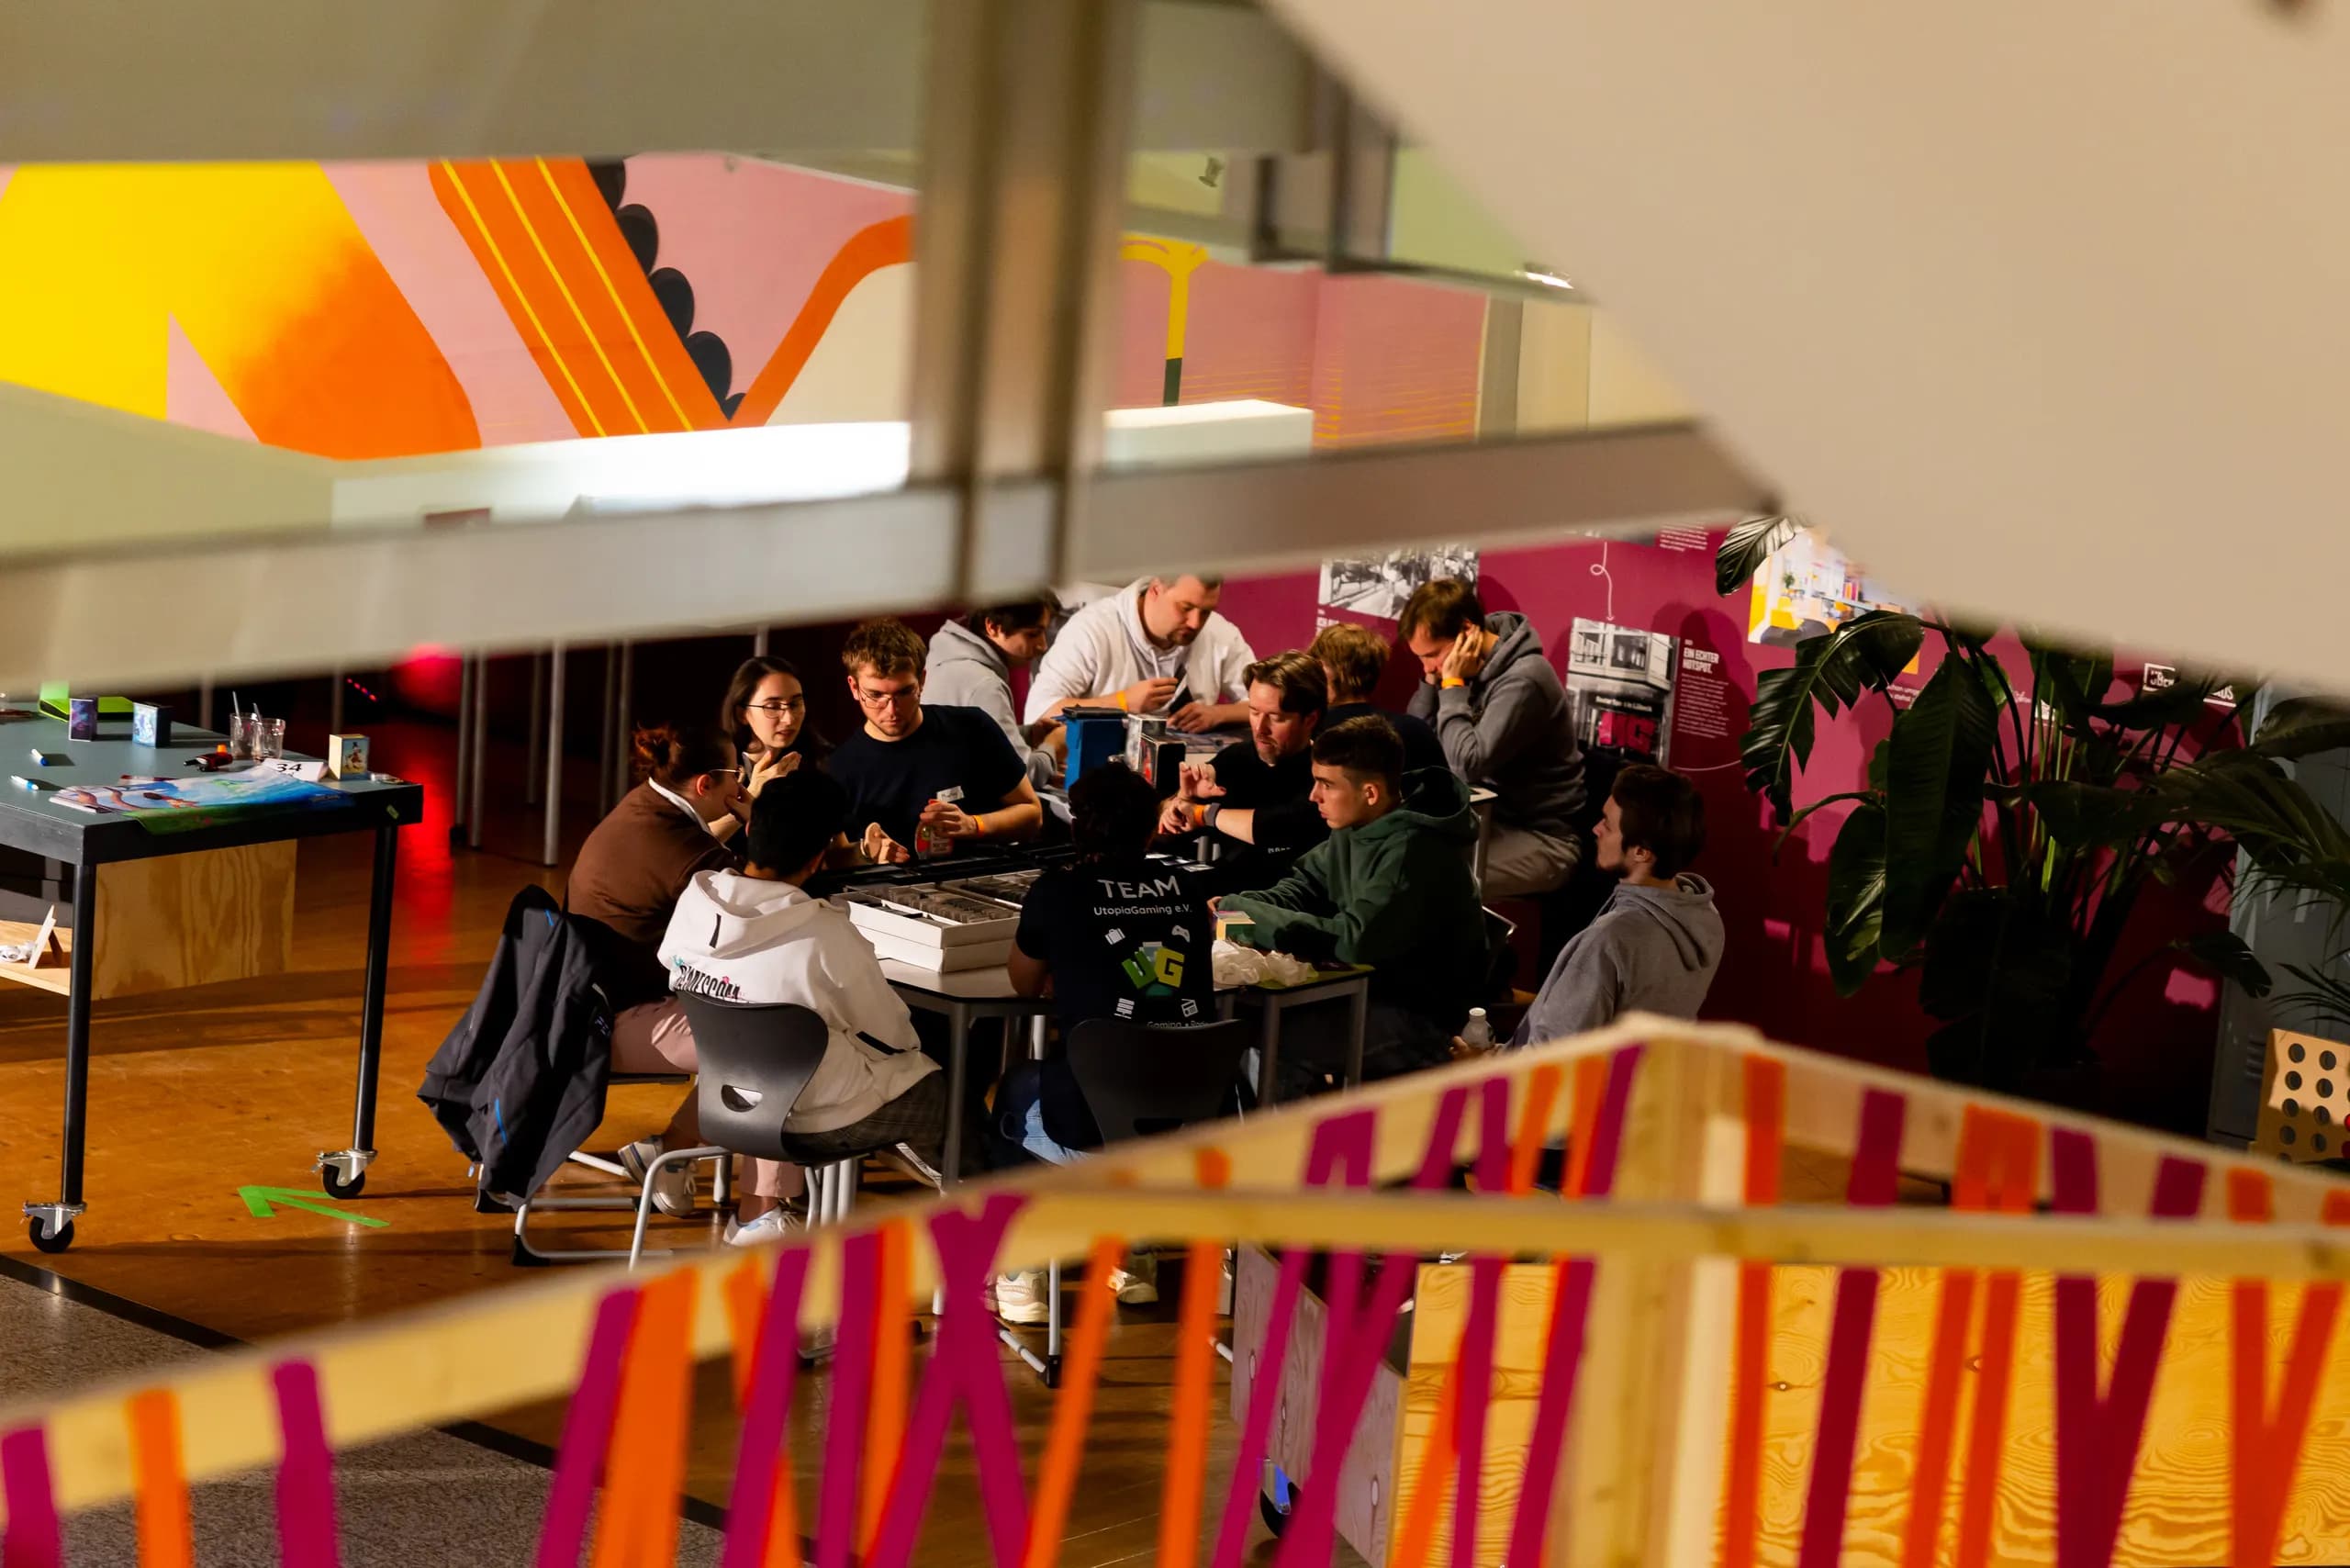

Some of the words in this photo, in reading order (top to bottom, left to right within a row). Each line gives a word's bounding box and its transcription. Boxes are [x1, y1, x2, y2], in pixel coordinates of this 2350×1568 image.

[276, 763, 302, 773] 34
[1097, 875, 1181, 899] TEAM
[1093, 905, 1173, 916] UtopiaGaming
[1175, 903, 1193, 913] e.V.
